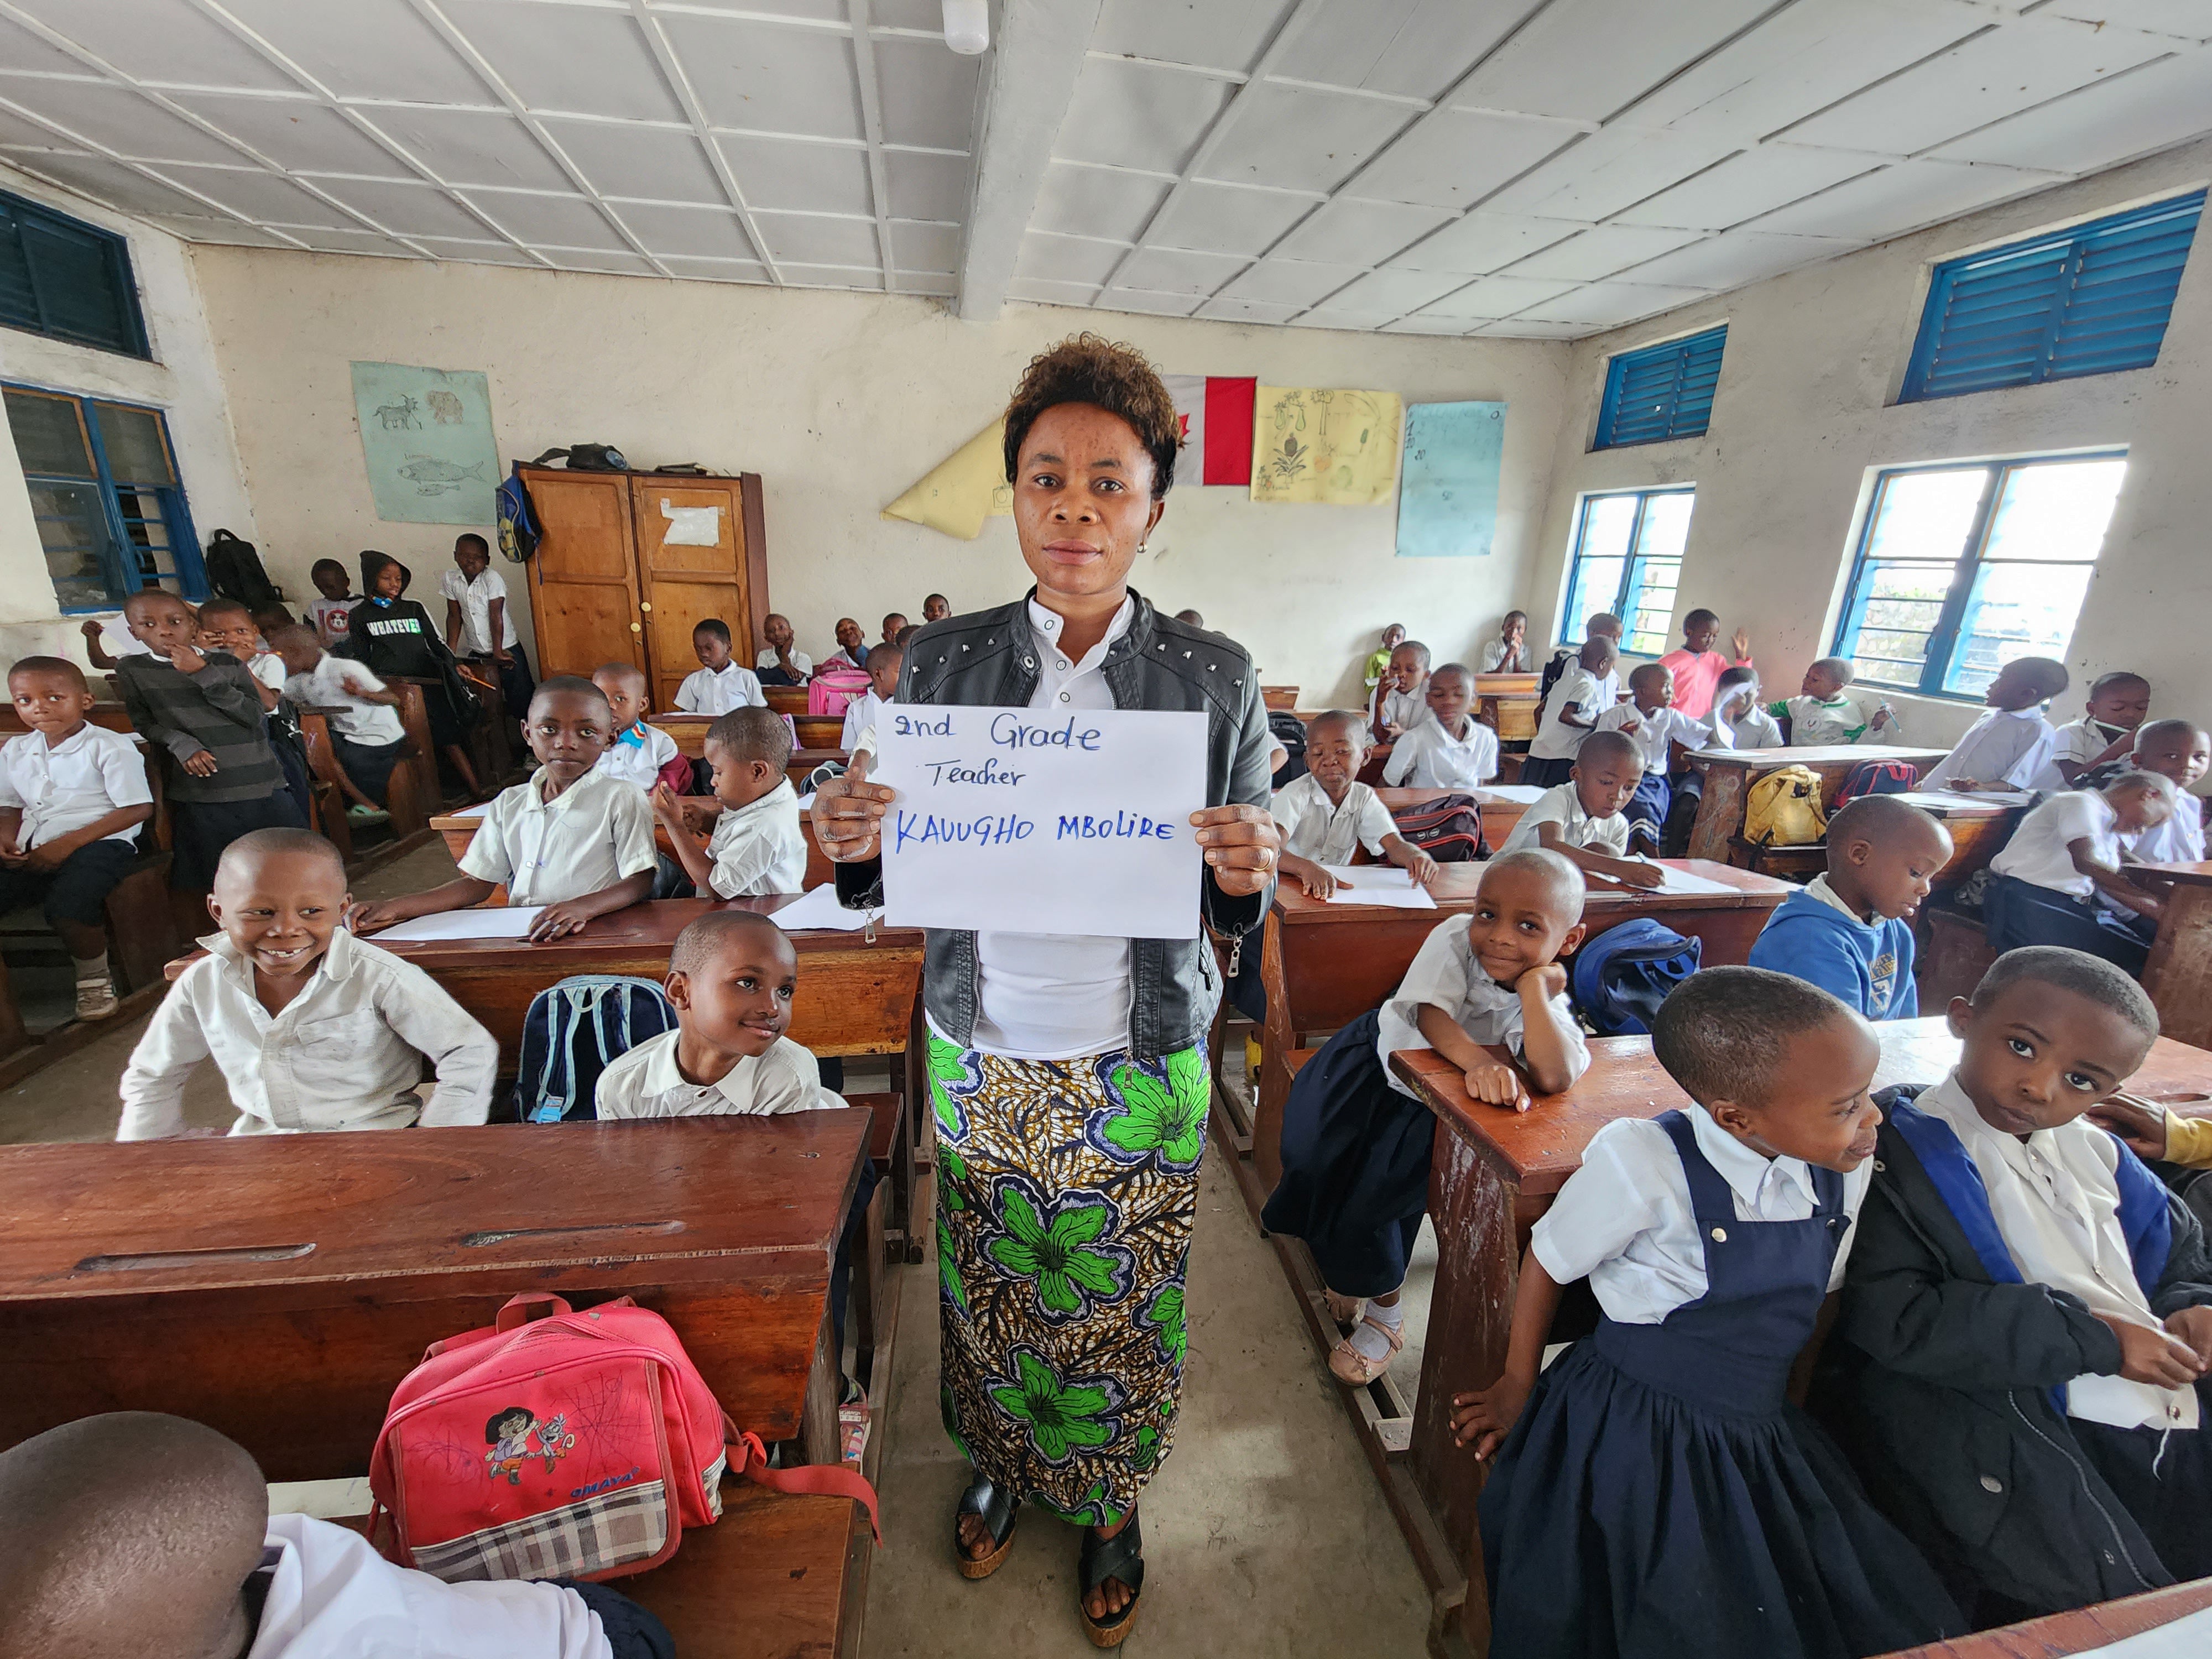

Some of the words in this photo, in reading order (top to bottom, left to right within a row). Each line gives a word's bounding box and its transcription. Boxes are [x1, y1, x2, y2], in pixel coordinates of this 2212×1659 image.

[895, 713, 956, 737] 2nd
[990, 712, 1101, 751] Grade
[924, 757, 1026, 786] Teacher
